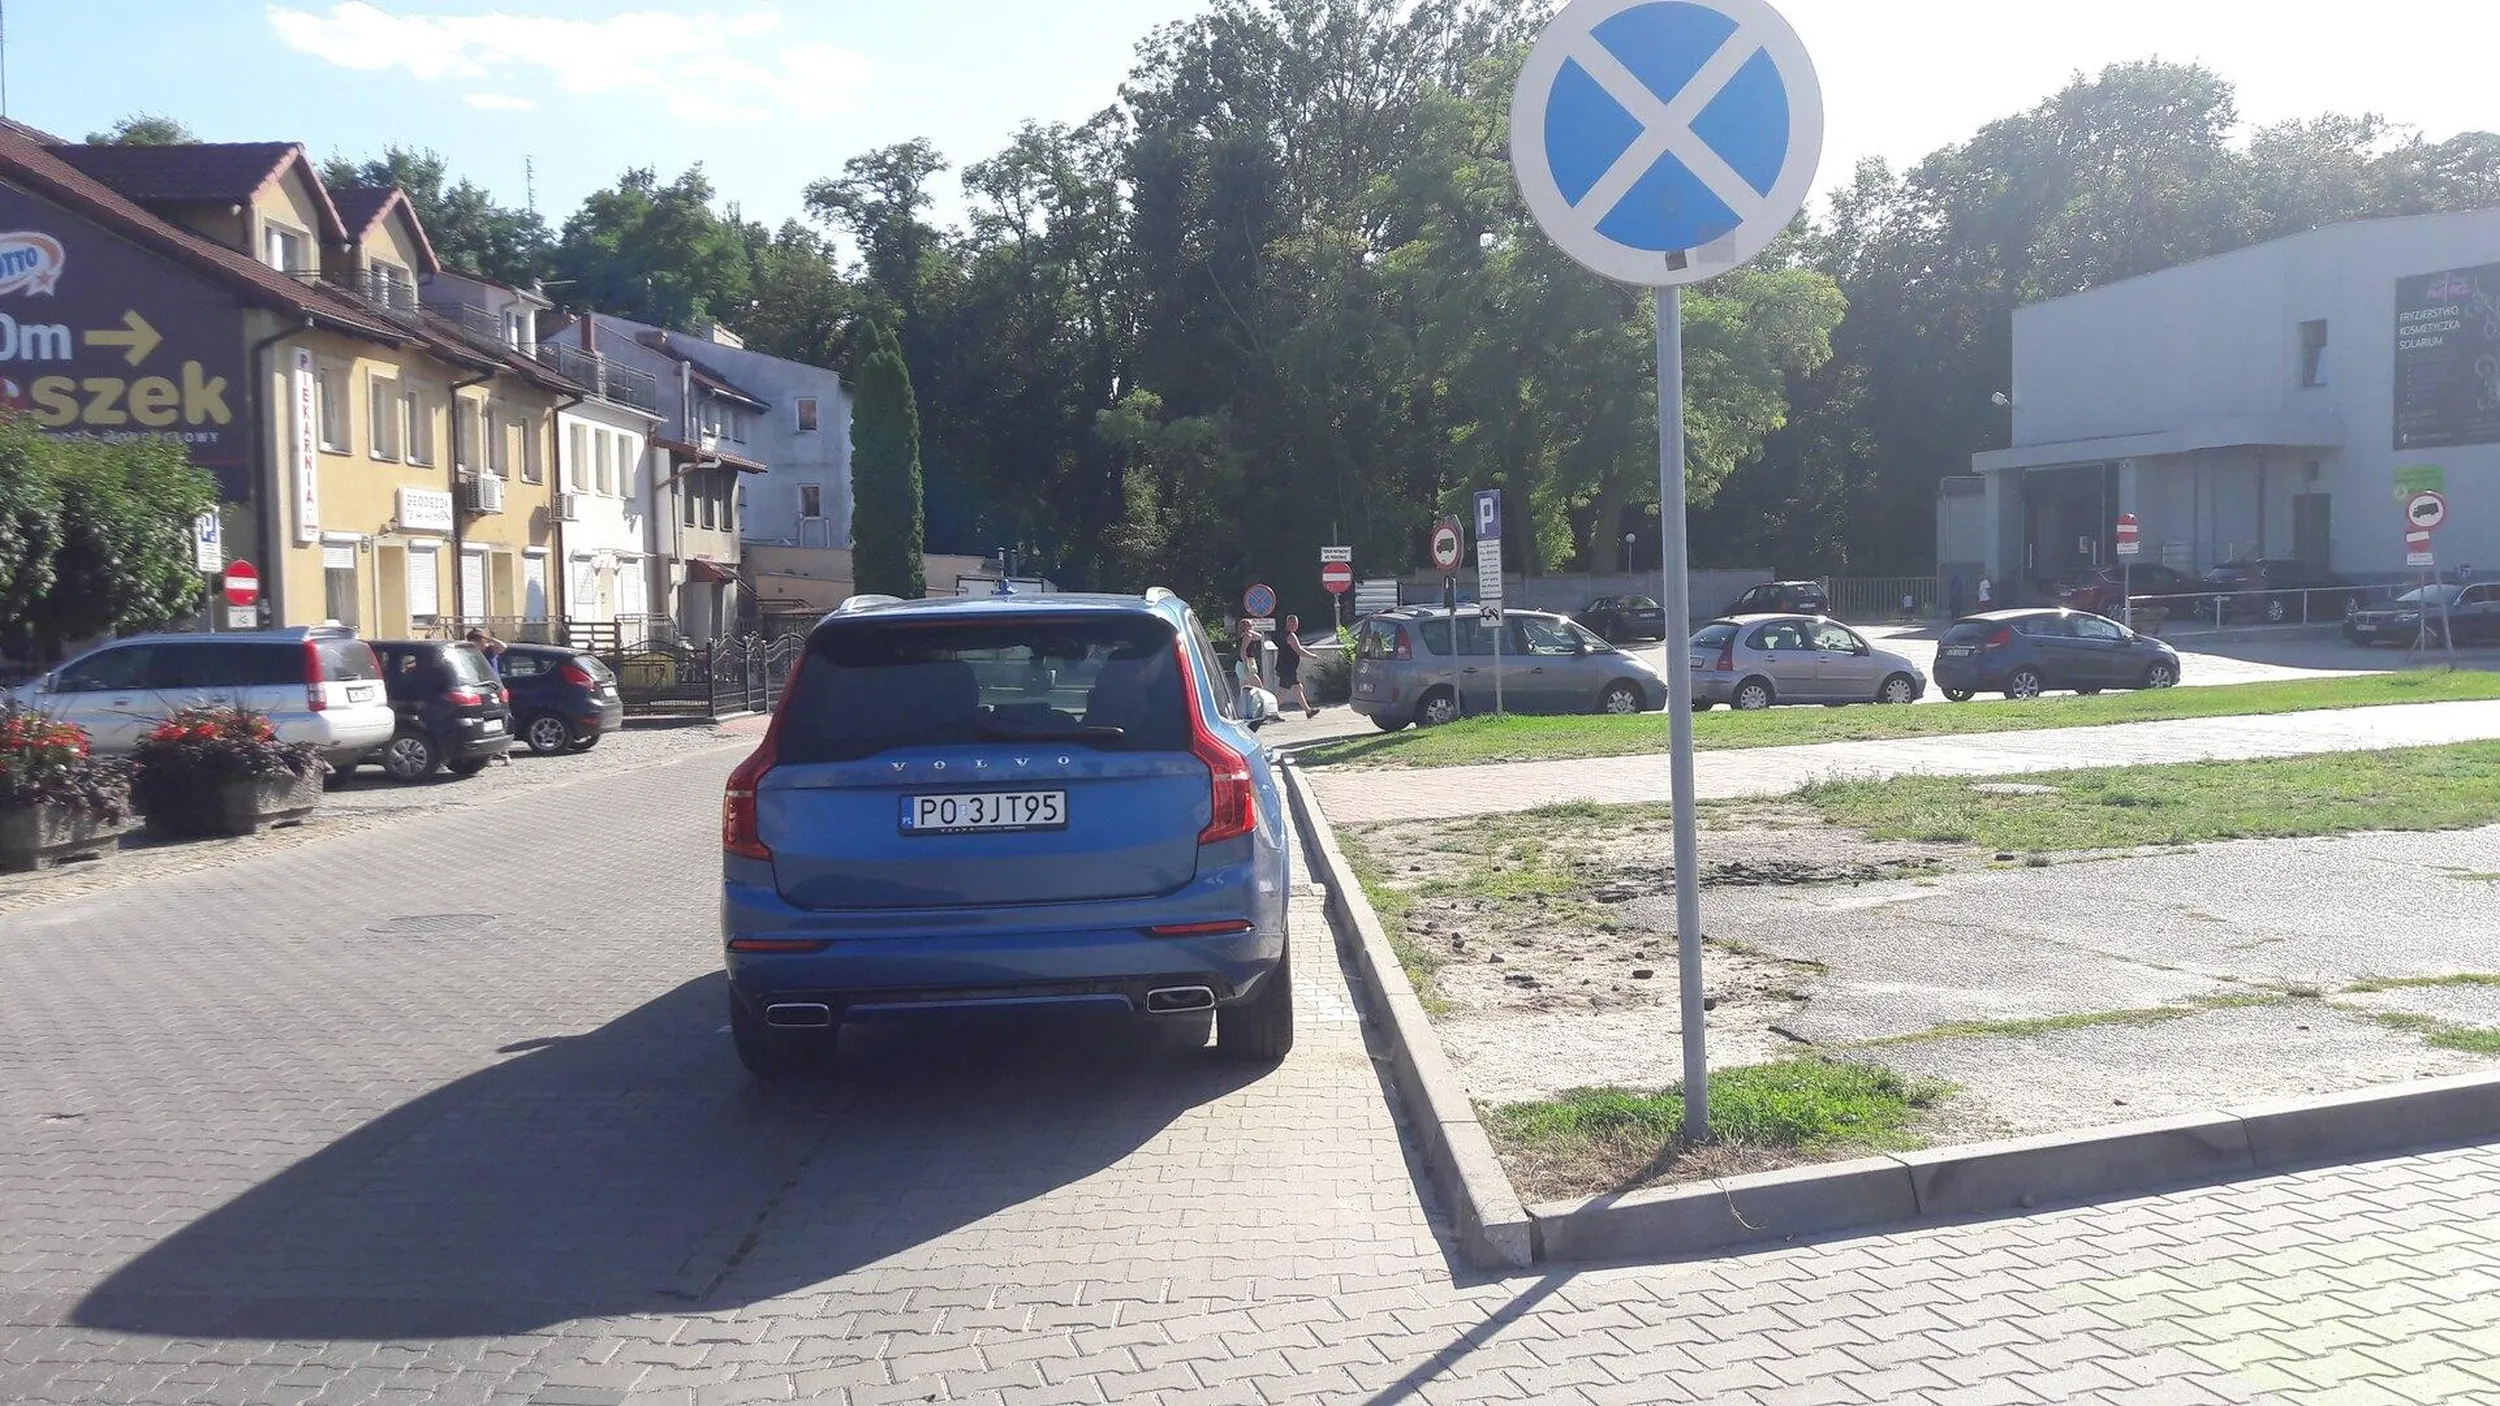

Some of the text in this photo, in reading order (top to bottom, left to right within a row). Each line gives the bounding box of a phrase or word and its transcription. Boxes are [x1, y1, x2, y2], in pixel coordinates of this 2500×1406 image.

[2399, 336, 2443, 350] SOLARIUM
[300, 352, 314, 504] PIEKARNIA
[1479, 497, 1494, 535] P
[891, 755, 1070, 772] VOLVO
[920, 795, 1057, 825] PO 3JT95
